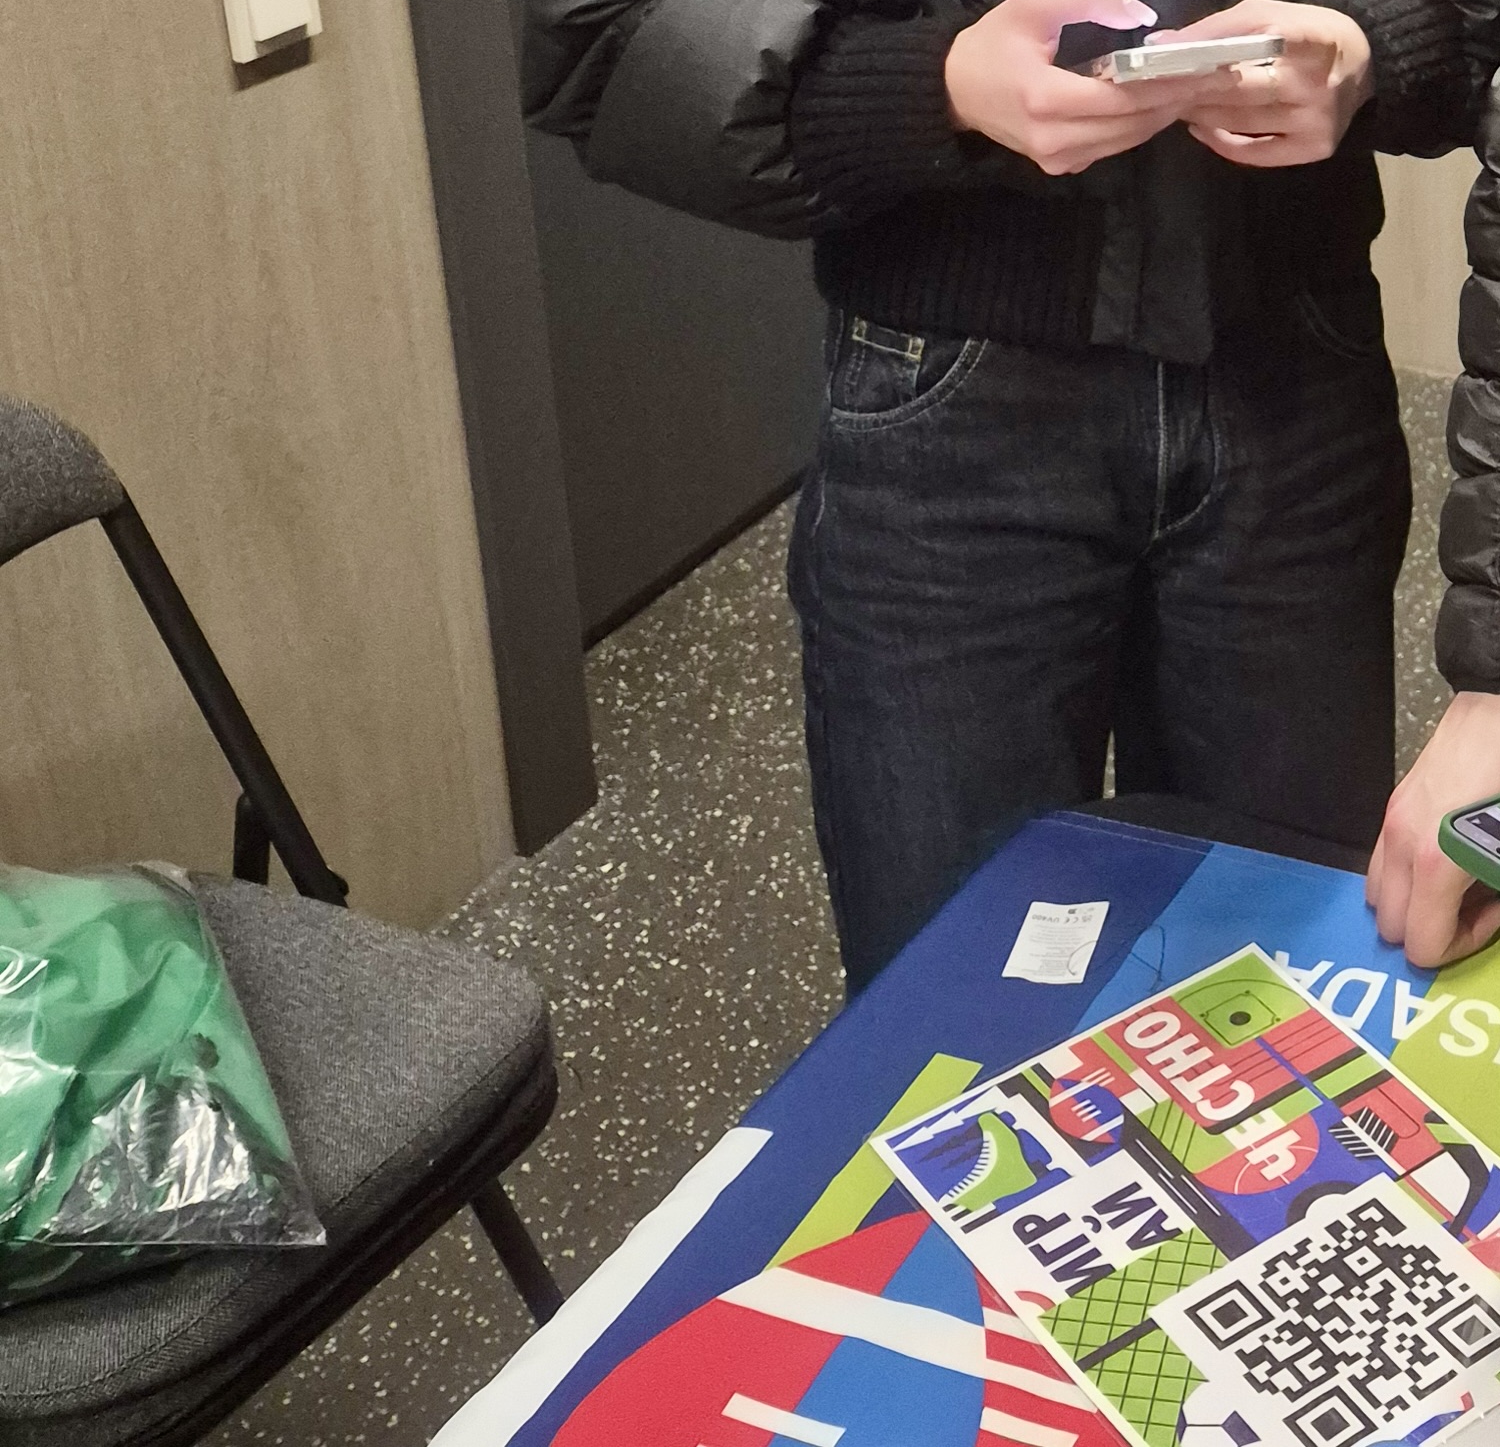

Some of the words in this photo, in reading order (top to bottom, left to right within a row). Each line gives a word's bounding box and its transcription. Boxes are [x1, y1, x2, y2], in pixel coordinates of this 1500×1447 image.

[1122, 1011, 1301, 1182] ЧЕСТНО
[1012, 1212, 1117, 1298] ИГР
[1080, 1181, 1184, 1251] АЙ
